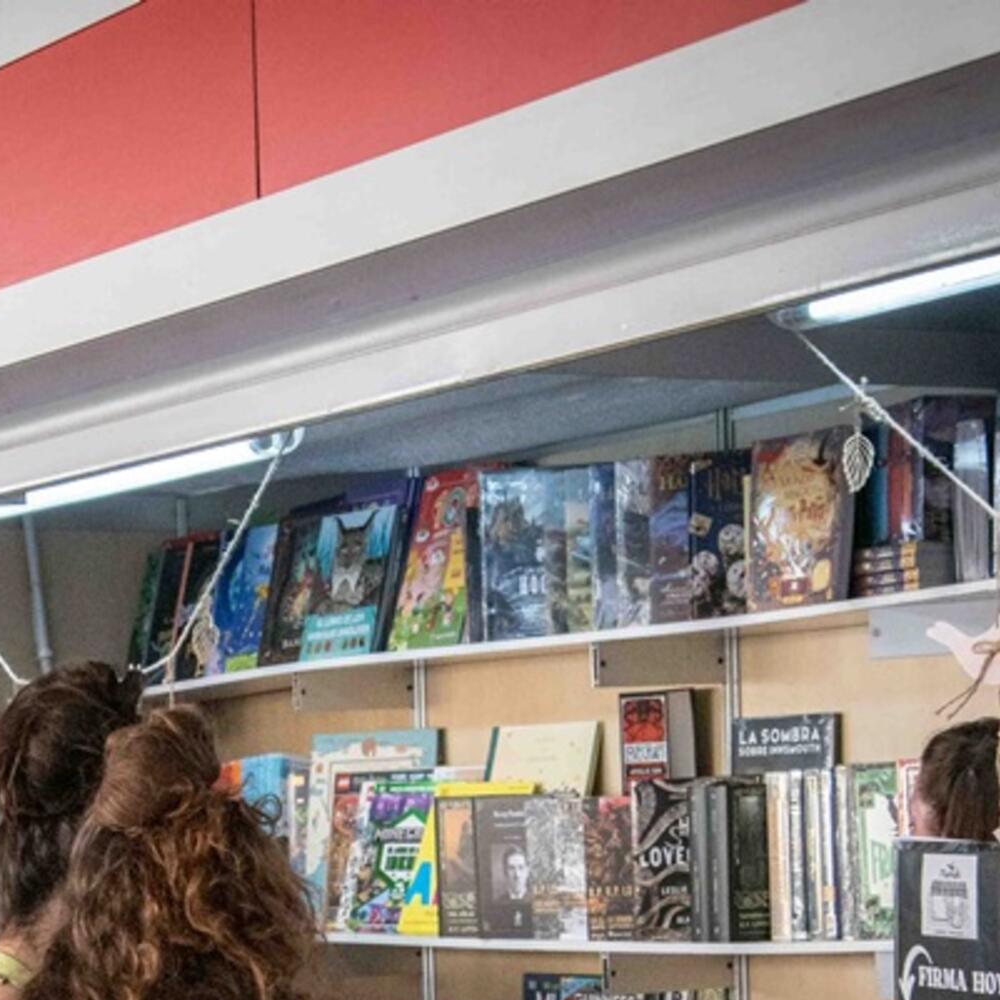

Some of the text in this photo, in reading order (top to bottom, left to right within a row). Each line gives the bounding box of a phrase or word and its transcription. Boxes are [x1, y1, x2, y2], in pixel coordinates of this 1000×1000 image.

[738, 727, 820, 745] LA SOMBRA
[640, 846, 690, 867] LOVE
[918, 966, 968, 992] FIRMA
